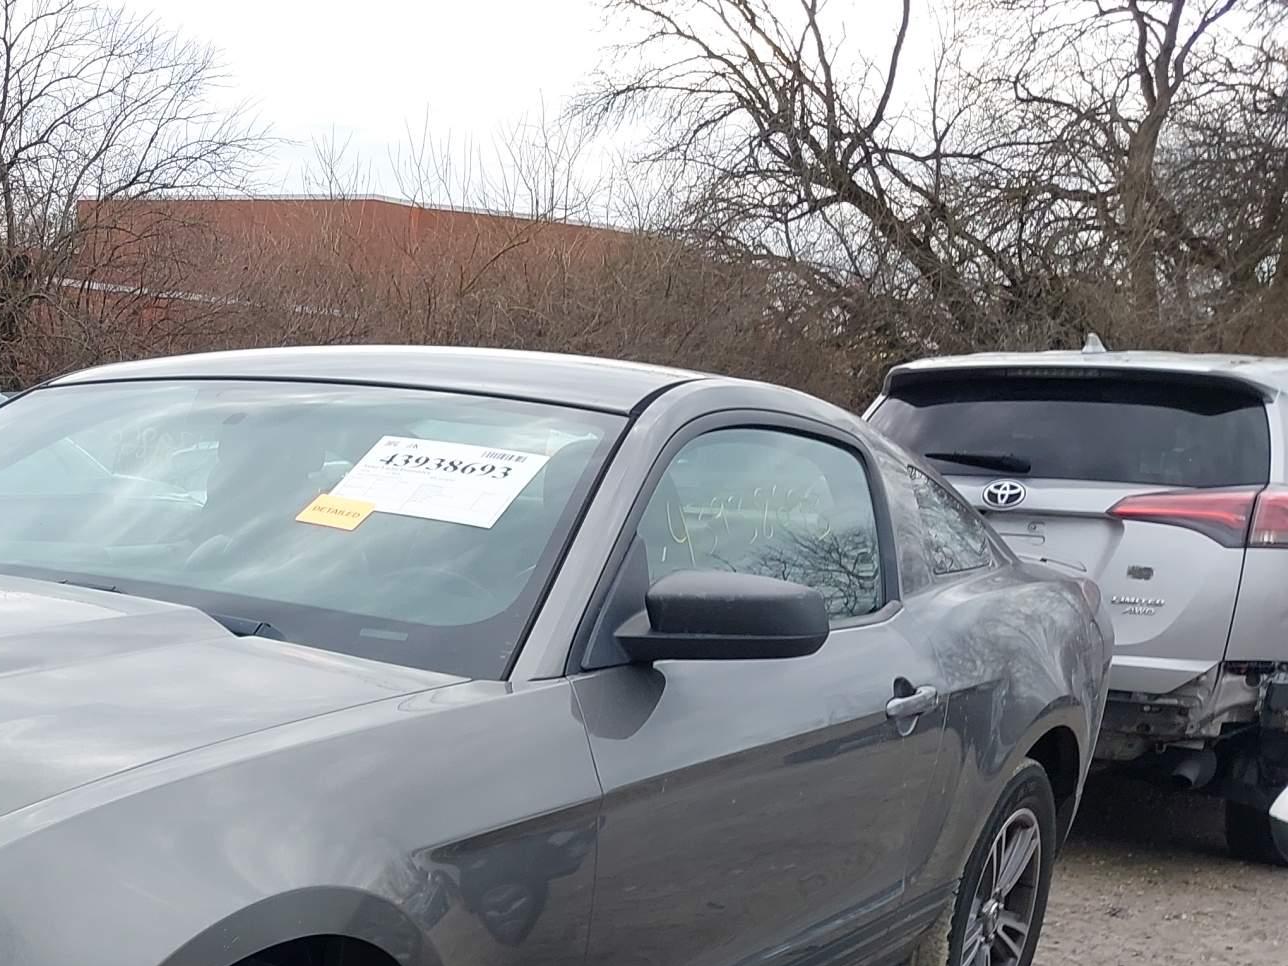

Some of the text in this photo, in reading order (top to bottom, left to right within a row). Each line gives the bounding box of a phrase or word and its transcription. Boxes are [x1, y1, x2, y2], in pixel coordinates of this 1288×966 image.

[379, 452, 513, 480] 43938693
[312, 505, 361, 519] DETAILED
[1111, 595, 1165, 607] LIMITED
[1121, 606, 1156, 616] AWD
